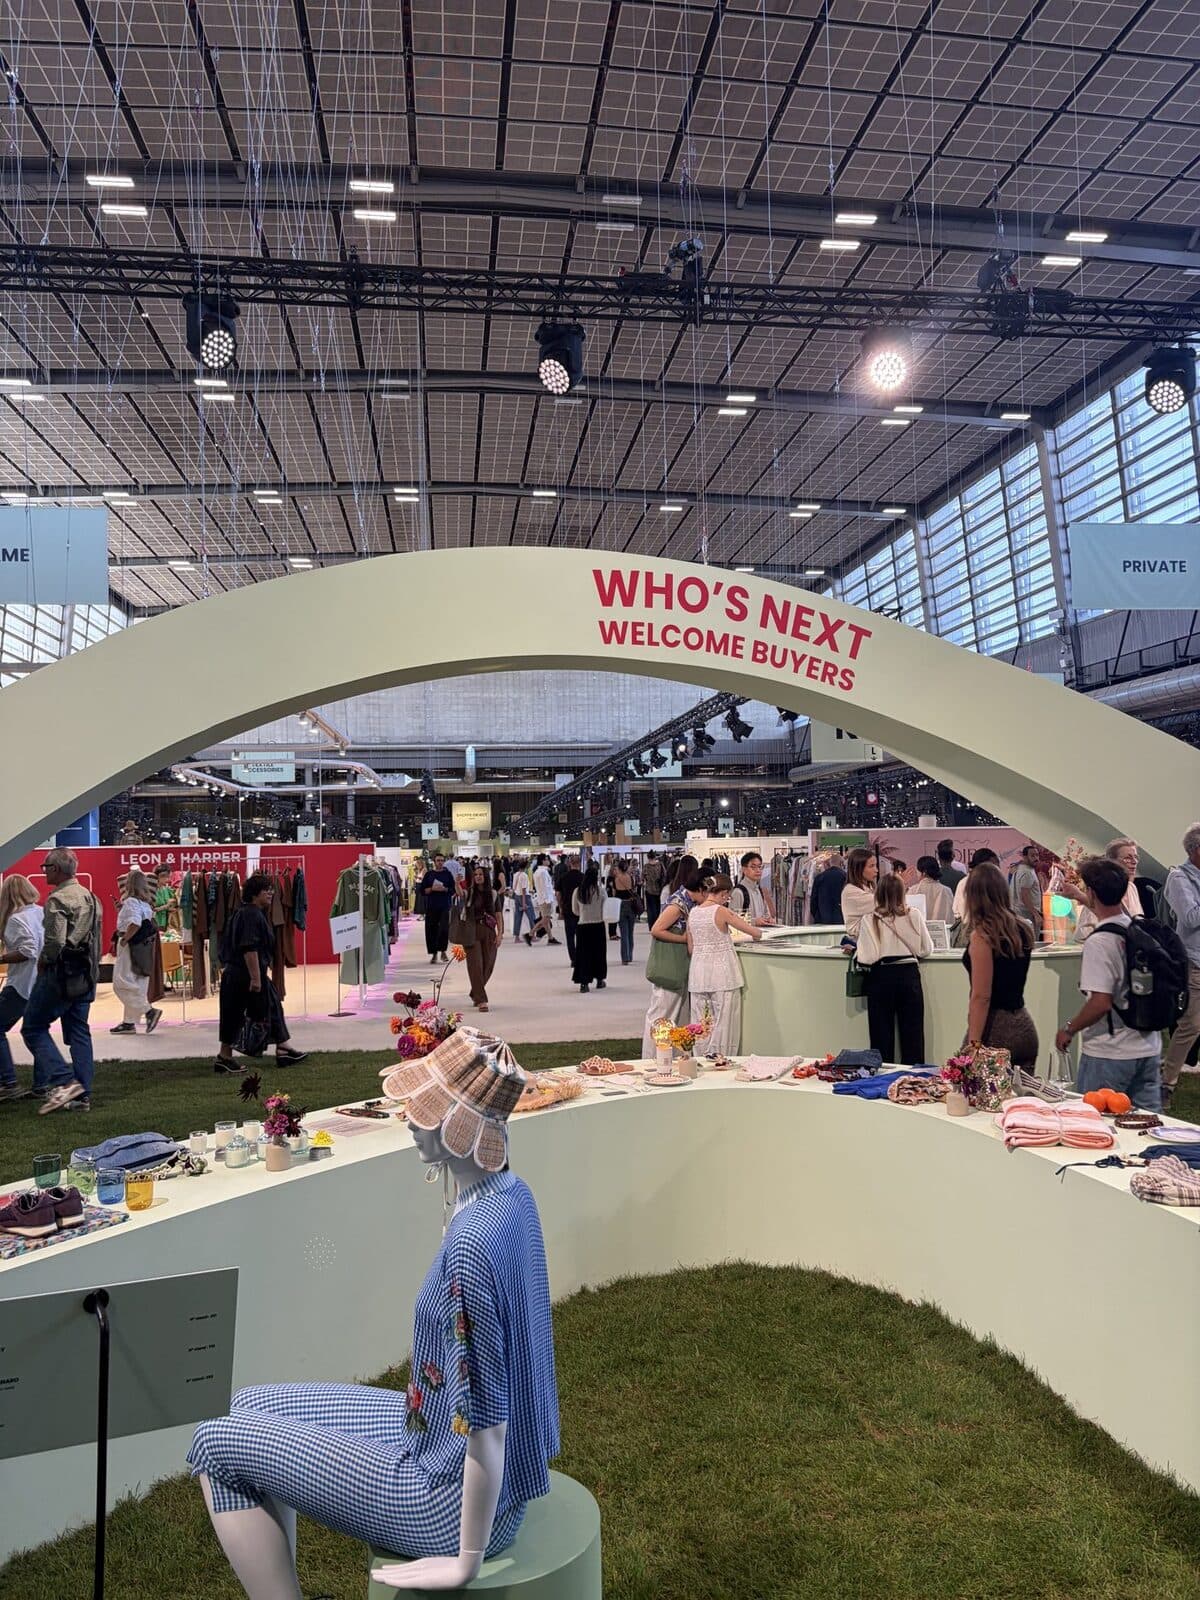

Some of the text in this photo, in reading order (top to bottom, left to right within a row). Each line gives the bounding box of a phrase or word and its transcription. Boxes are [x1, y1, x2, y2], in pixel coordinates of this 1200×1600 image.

[0, 548, 30, 562] ME
[1122, 559, 1187, 573] PRIVATE
[592, 569, 873, 660] WHO'S NEXT
[598, 620, 856, 692] WELCOME BUYERS
[871, 746, 877, 755] L
[120, 851, 241, 865] LEON & HARPER
